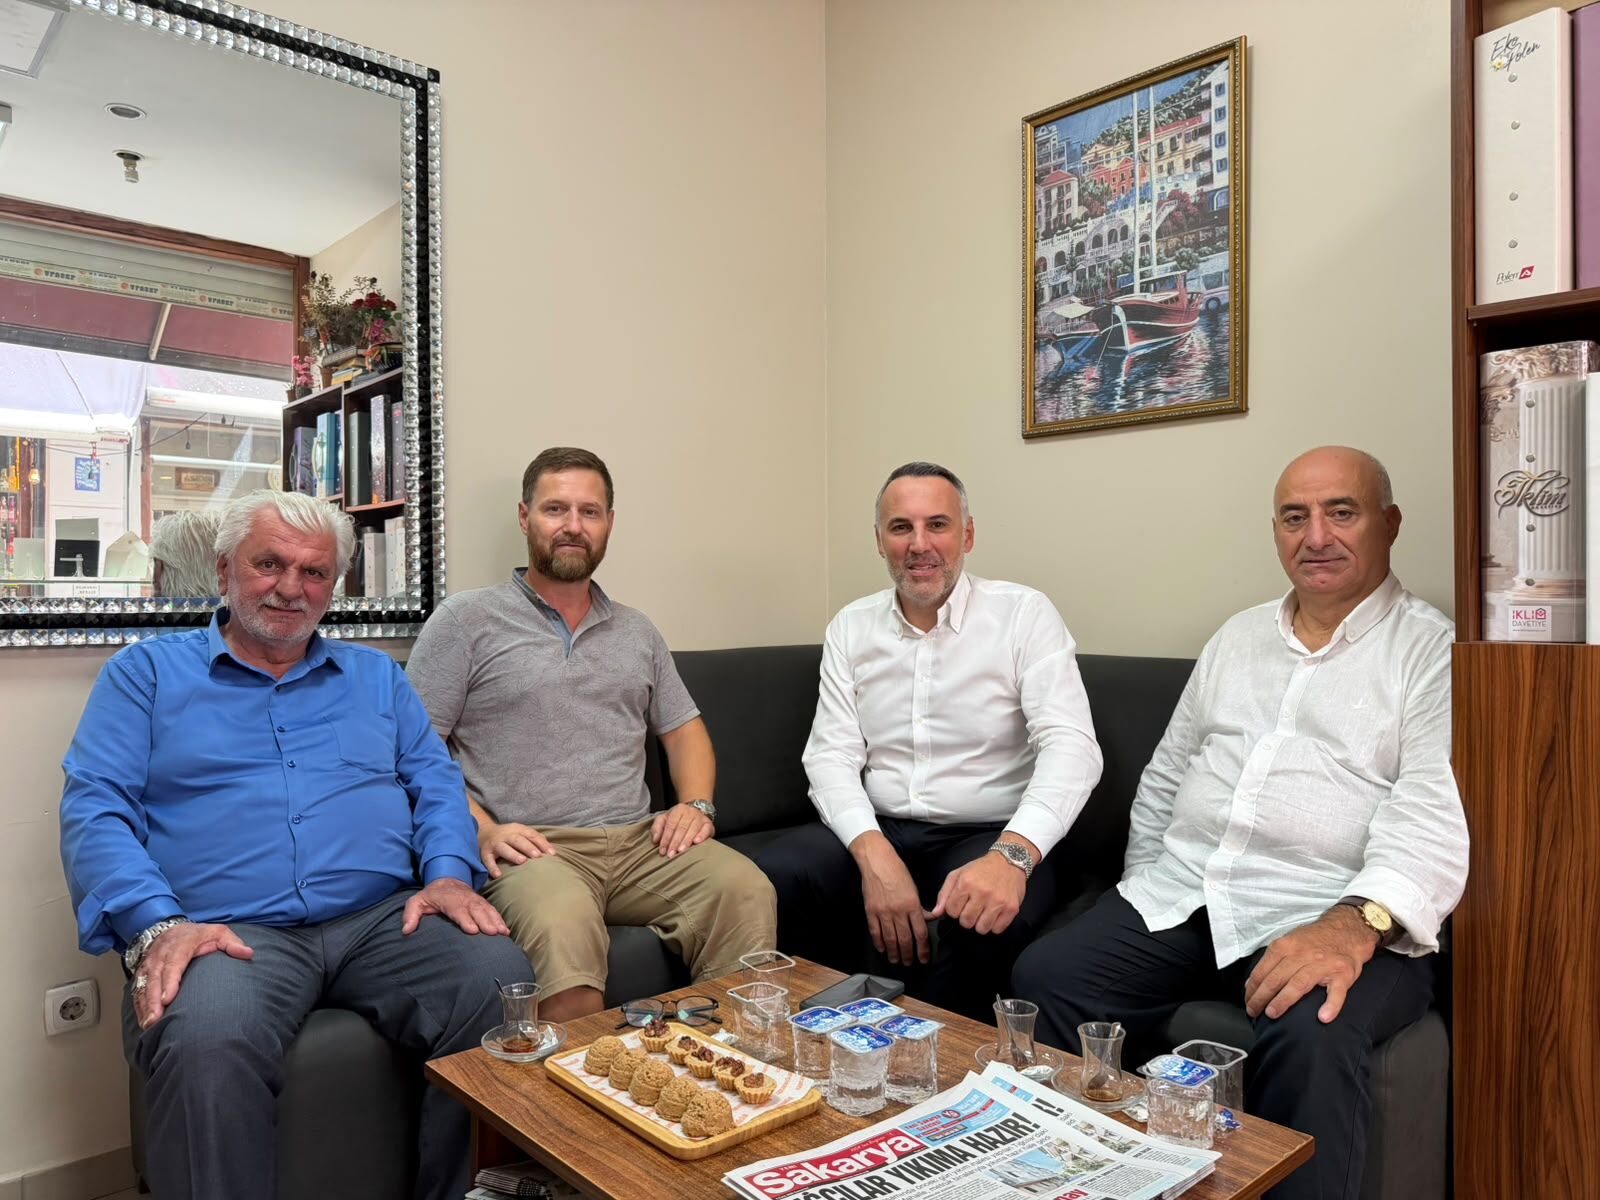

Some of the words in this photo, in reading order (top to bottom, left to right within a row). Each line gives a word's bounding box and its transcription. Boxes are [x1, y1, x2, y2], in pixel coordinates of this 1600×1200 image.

[753, 1135, 921, 1194] Sakarya
[883, 1144, 978, 1185] YIKIMA
[959, 1112, 1041, 1154] HAZIR!
